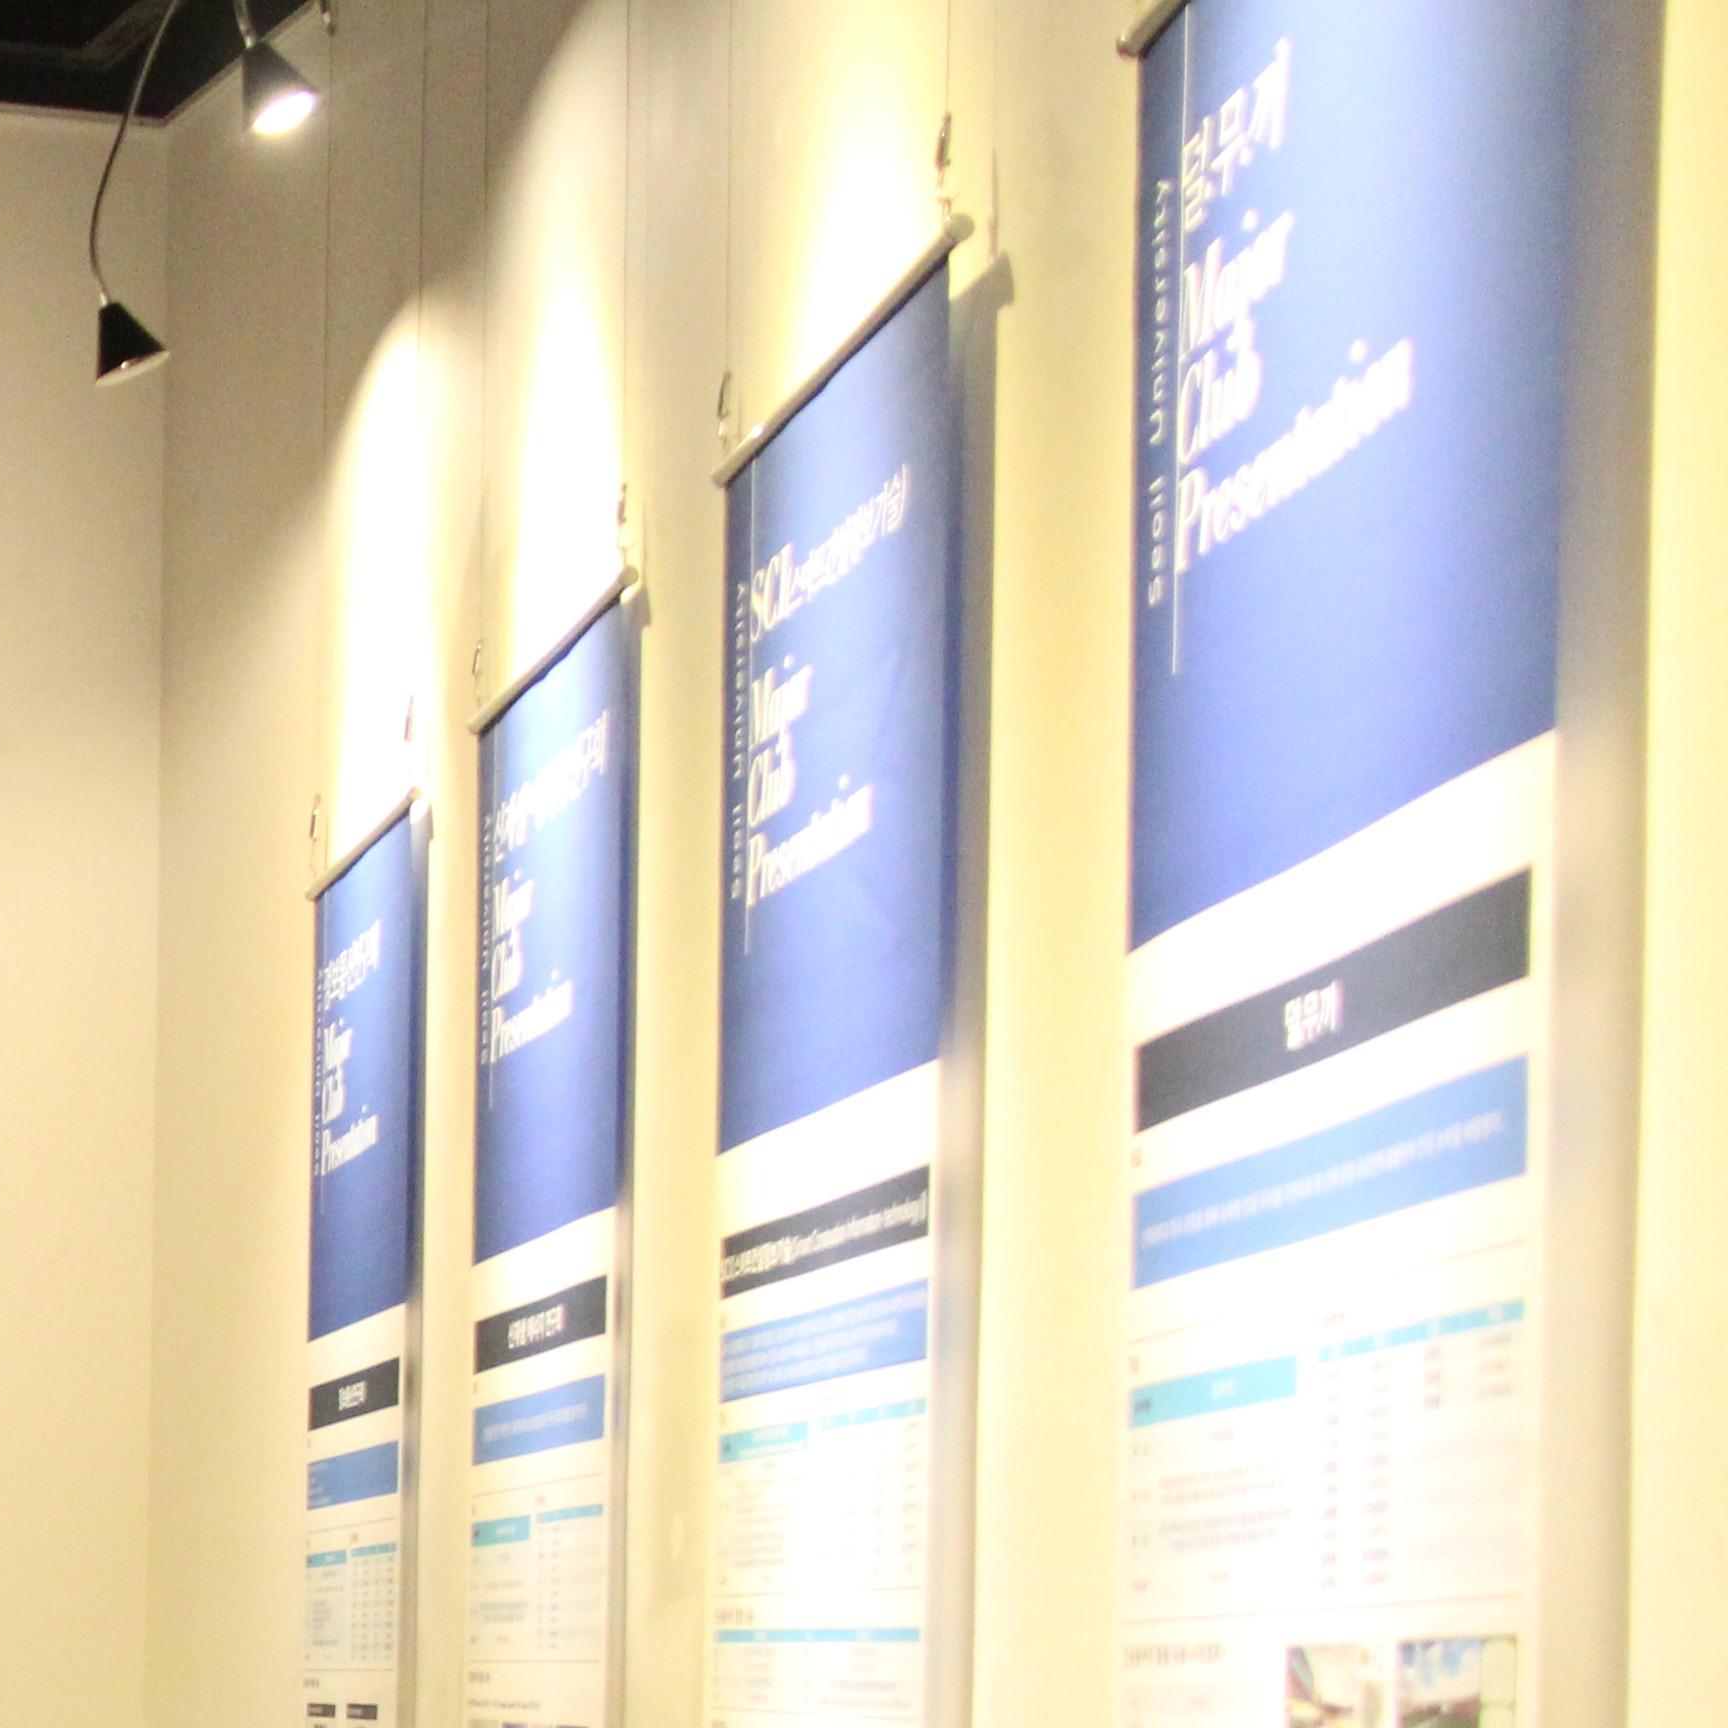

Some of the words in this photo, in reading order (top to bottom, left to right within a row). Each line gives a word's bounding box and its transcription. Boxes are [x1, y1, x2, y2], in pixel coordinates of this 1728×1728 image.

[1146, 177, 1174, 446] University
[1183, 207, 1296, 356] Major
[1178, 318, 1258, 467] Club
[1178, 338, 1414, 574] Presentation
[1146, 476, 1165, 608] Seoil
[750, 654, 814, 746] Major
[747, 773, 874, 908] Presentation
[748, 734, 796, 829] Club
